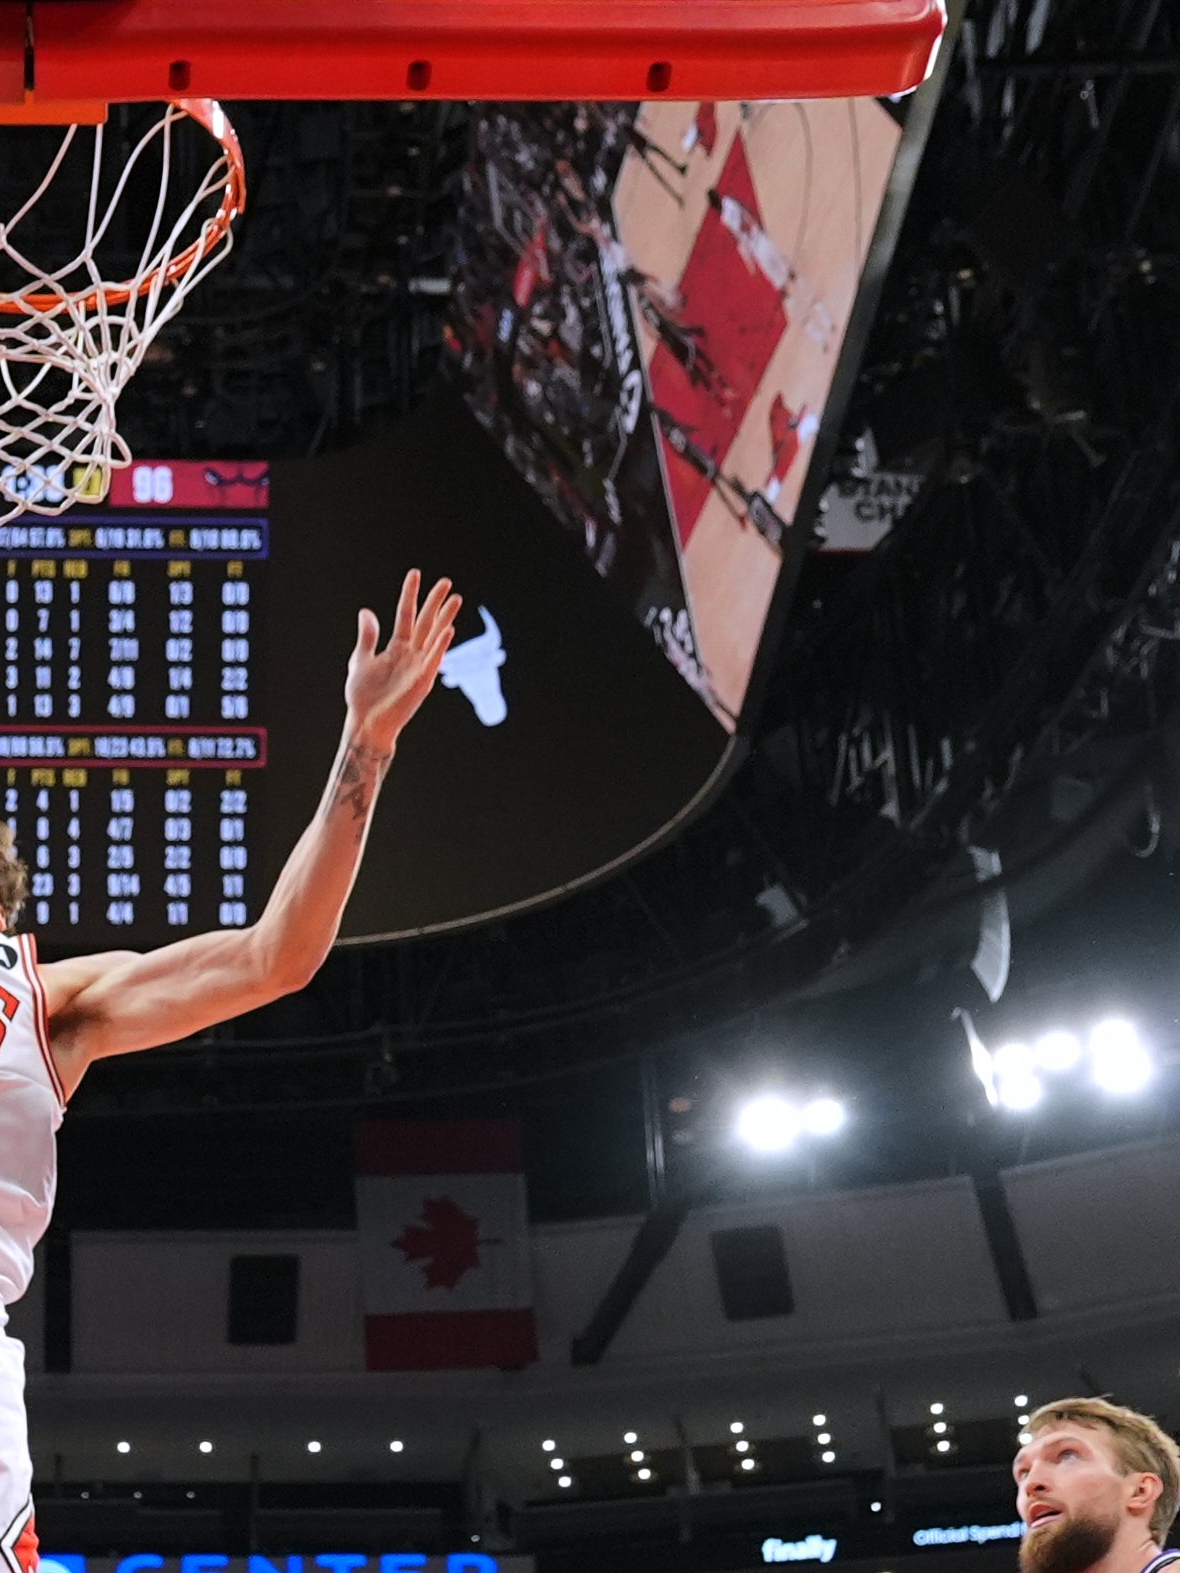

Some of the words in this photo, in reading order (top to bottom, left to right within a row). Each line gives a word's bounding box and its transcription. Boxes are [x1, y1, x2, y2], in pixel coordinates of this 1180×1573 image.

[38, 609, 49, 632] 7
[6, 637, 18, 660] 2
[69, 637, 80, 660] 7
[6, 666, 18, 688] 3
[68, 666, 80, 689] 2
[8, 694, 16, 716] 1
[6, 789, 17, 811] 2
[37, 790, 48, 810] 4
[70, 790, 79, 811] 1
[68, 818, 80, 839] 4
[70, 902, 78, 923] 1
[913, 1526, 969, 1546] Official
[969, 1522, 1020, 1544] Spend
[762, 1535, 837, 1563] finally
